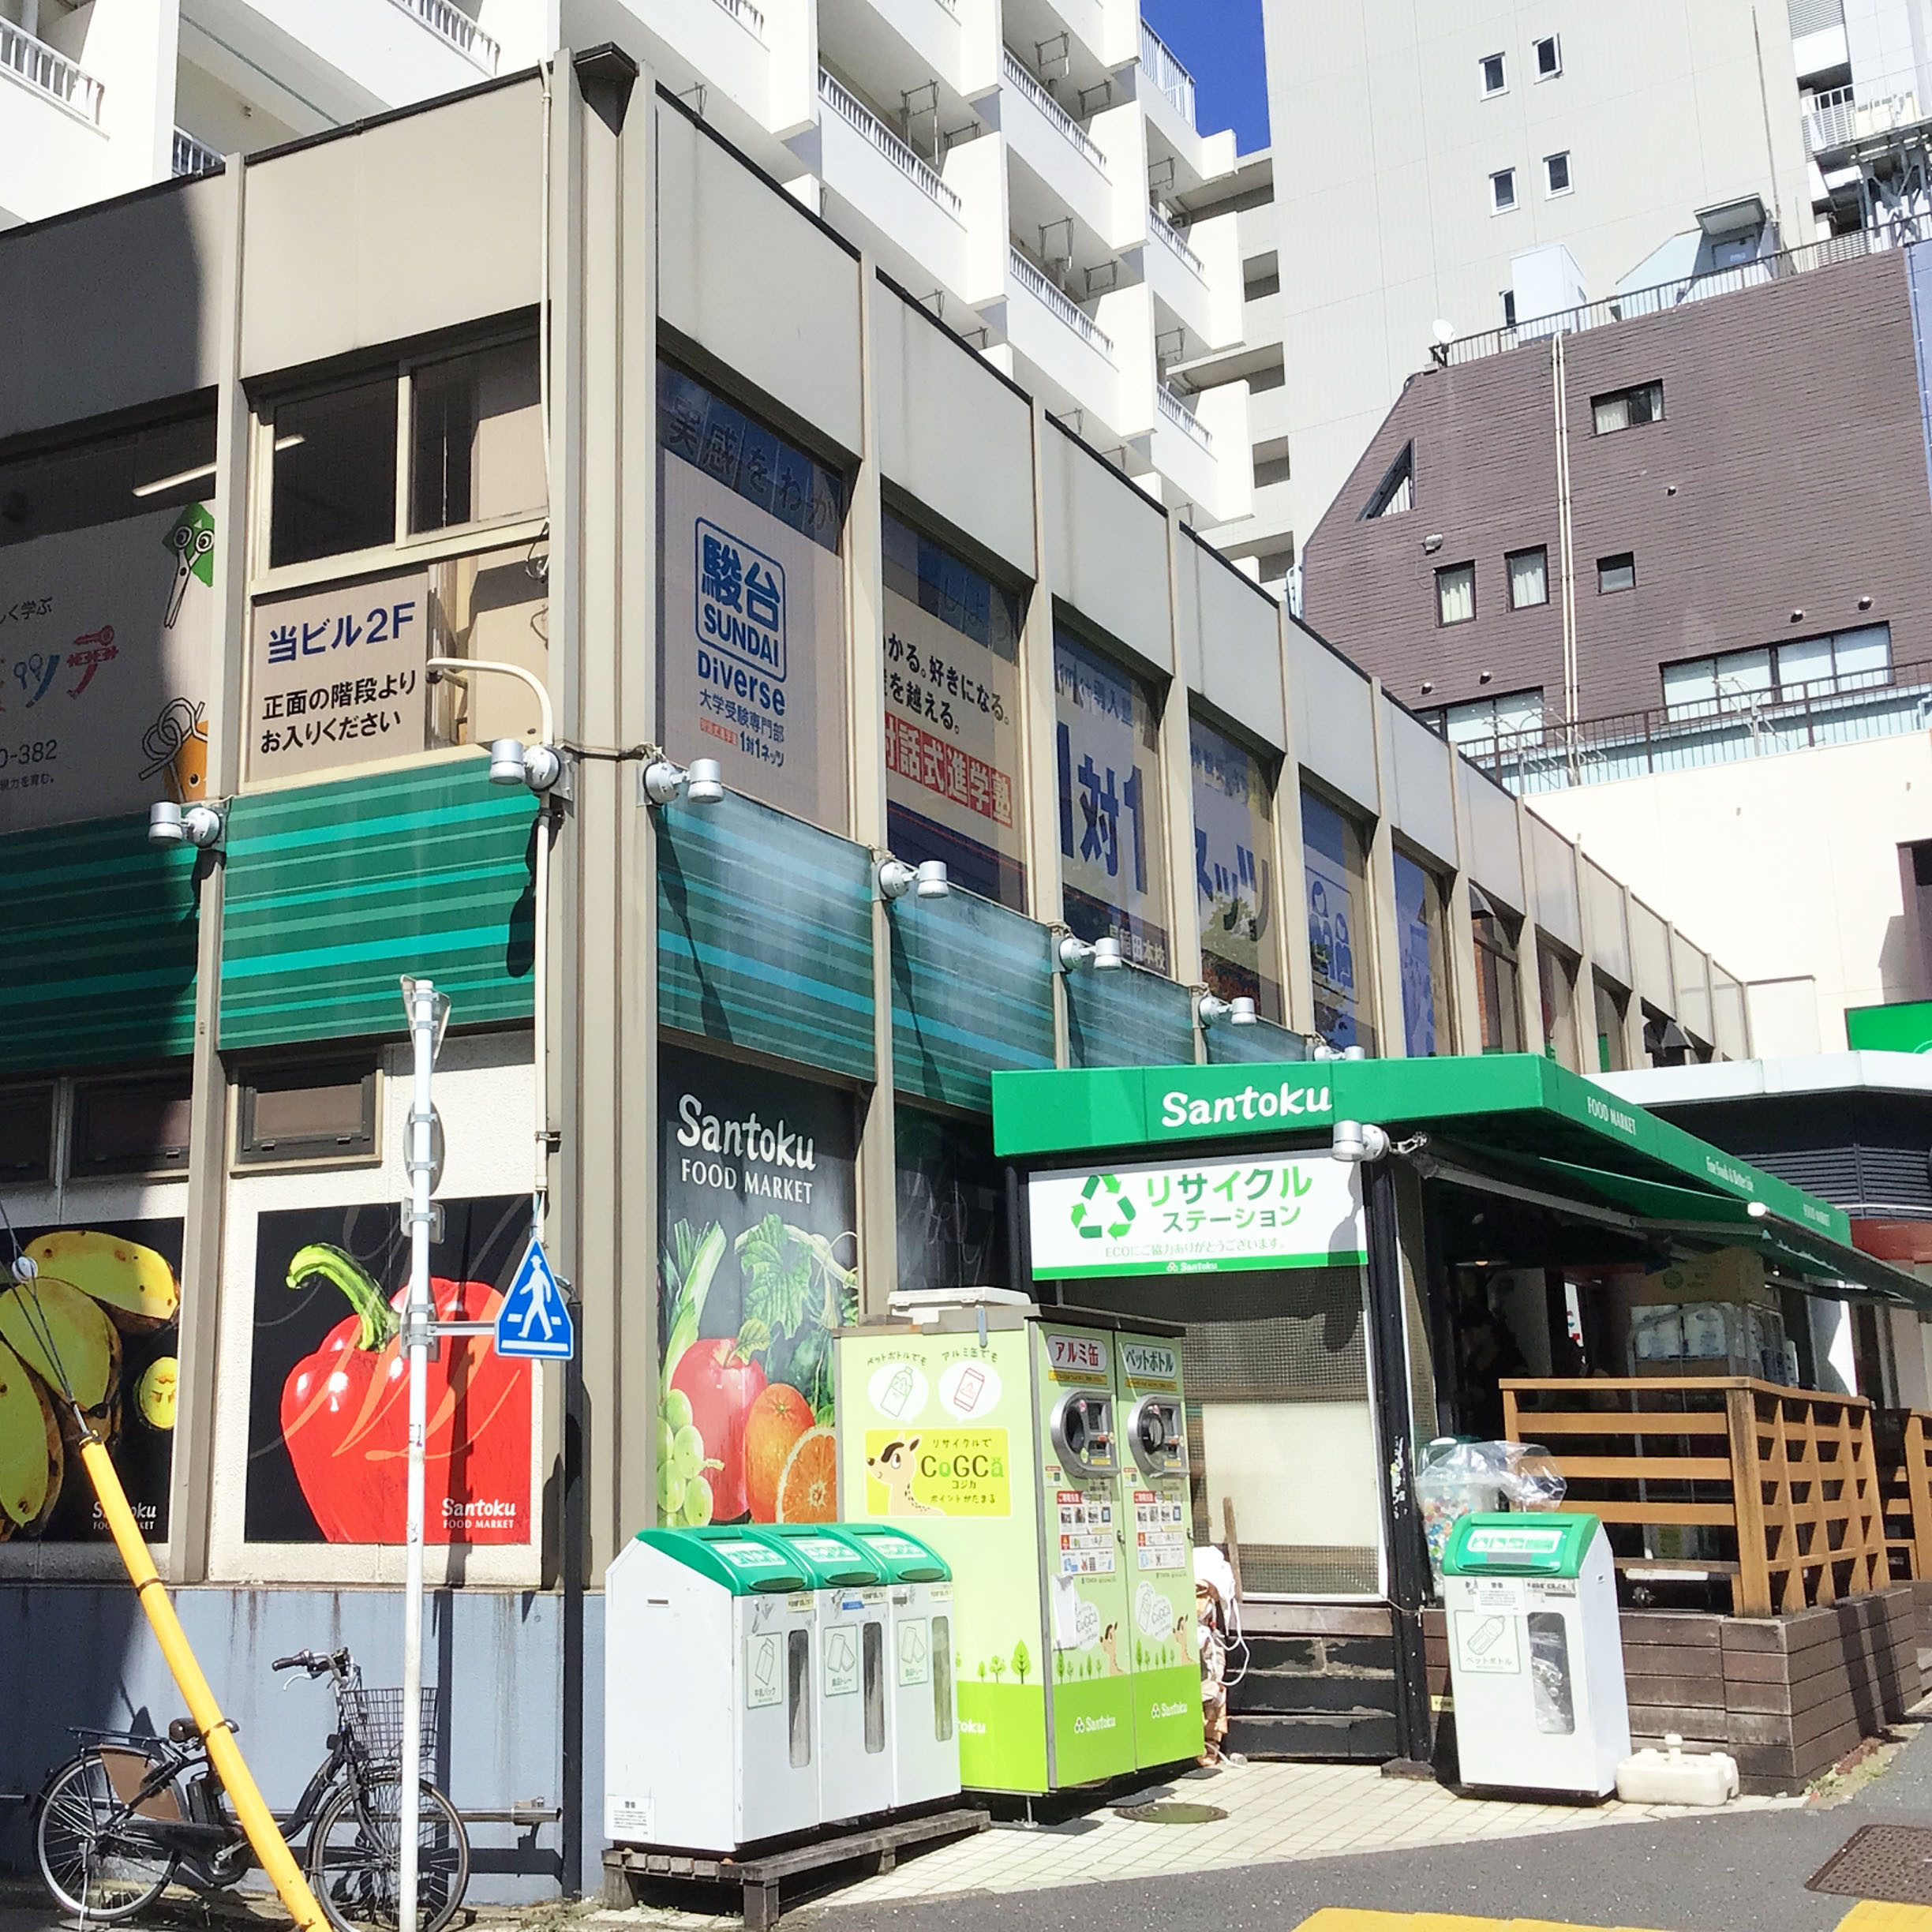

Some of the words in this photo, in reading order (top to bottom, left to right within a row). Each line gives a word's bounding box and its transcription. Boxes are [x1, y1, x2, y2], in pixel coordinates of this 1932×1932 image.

[702, 534, 781, 633] 駿台
[0, 597, 53, 624] く学ぶ
[268, 601, 416, 665] 当ビル2F
[704, 603, 779, 668] SUNDAI
[262, 670, 416, 721] 正面の階段より
[698, 649, 785, 717] Diverse
[883, 632, 1009, 726] かる。好きになる。
[884, 668, 960, 735] を越える。
[260, 711, 401, 754] お入りください
[1162, 1082, 1333, 1128] Santoku
[1587, 1095, 1609, 1121] FOOD
[676, 1094, 816, 1171] Santoku
[681, 1158, 738, 1190] FOOD
[744, 1170, 813, 1204] MARKET
[1147, 1166, 1313, 1208] リサイクル
[1162, 1204, 1302, 1234] ステーション
[1180, 1261, 1219, 1272] Santoku
[1054, 1341, 1099, 1367] アルミ缶
[1125, 1348, 1175, 1373] ペットボトル
[951, 1479, 977, 1490] コジカ
[92, 1501, 157, 1518] Soku
[441, 1497, 517, 1518] Santoku
[443, 1519, 472, 1529] FOOD
[474, 1519, 515, 1529] MARKET
[1085, 1715, 1116, 1732] Santoku
